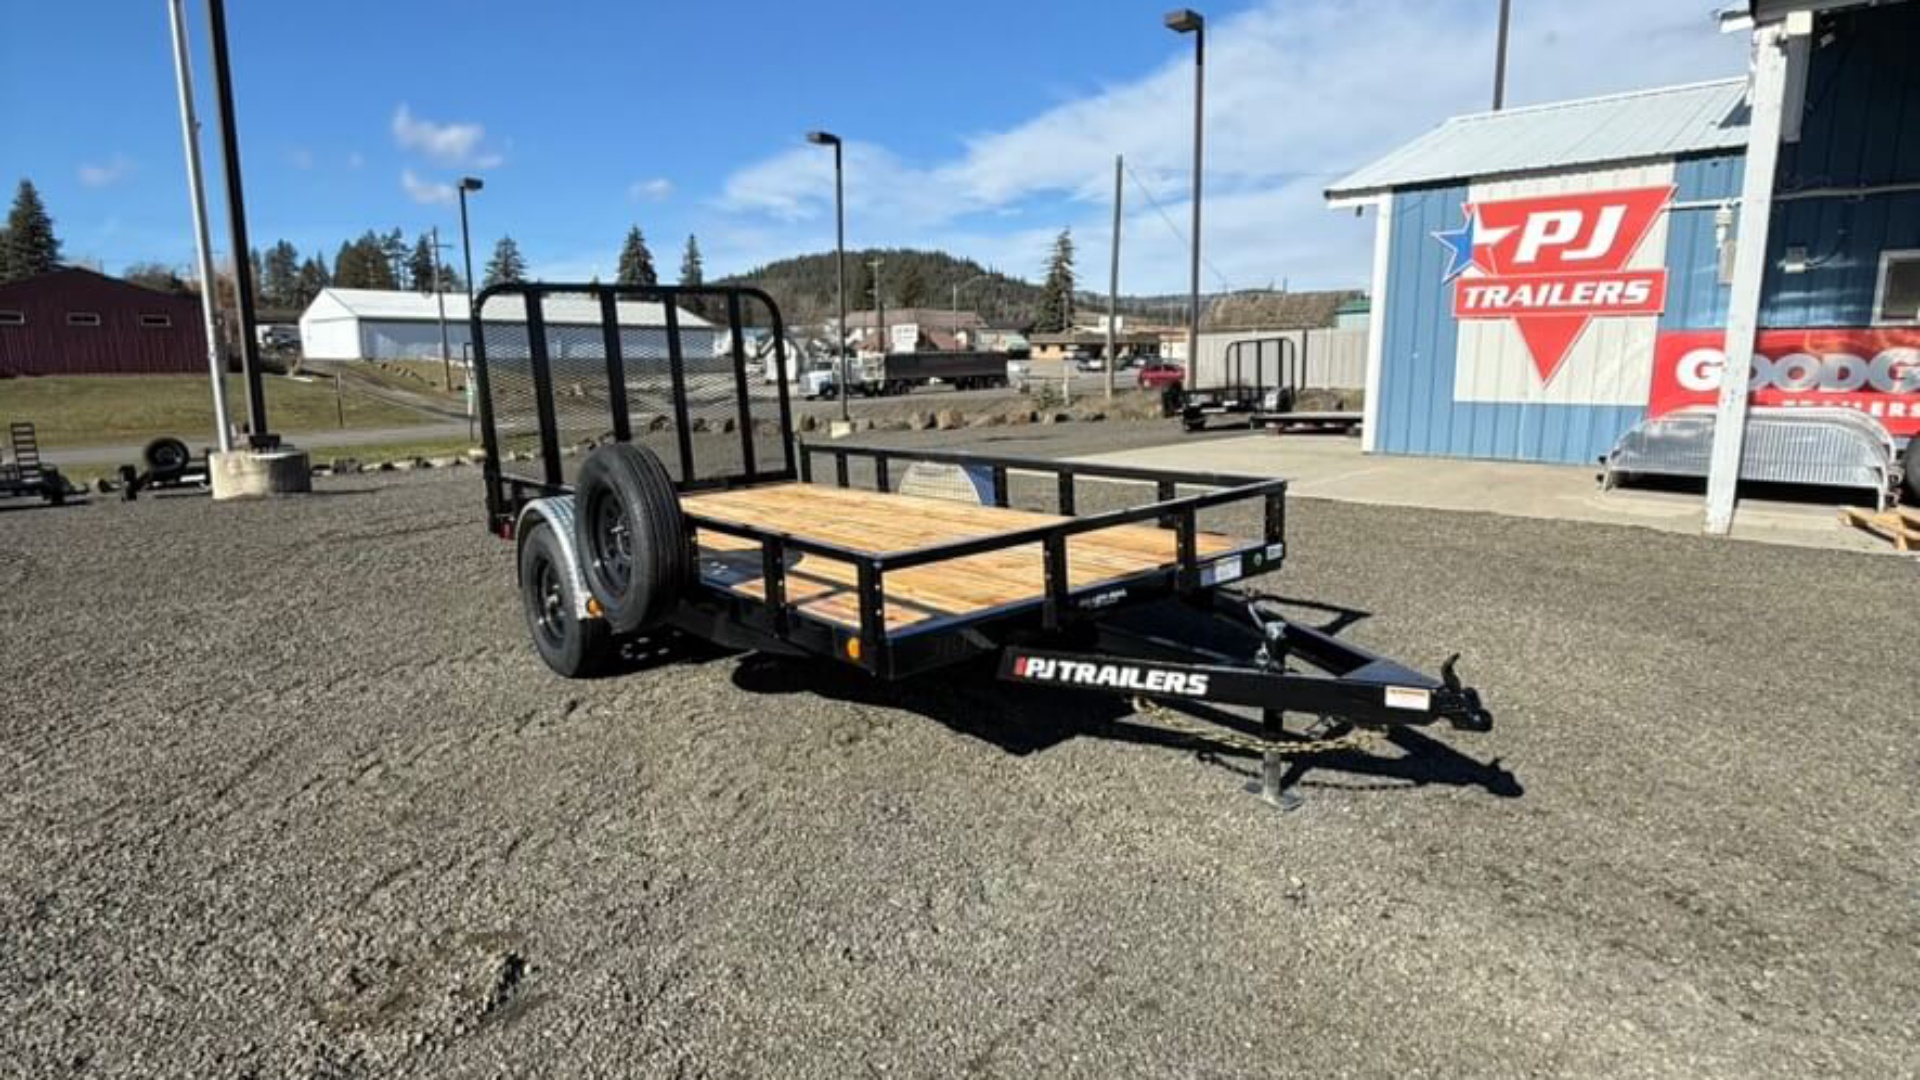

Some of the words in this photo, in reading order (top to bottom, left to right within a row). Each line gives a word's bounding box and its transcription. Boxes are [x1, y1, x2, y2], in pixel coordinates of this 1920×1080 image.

[1512, 204, 1628, 263] PJ
[1463, 279, 1653, 310] TRAILERS
[1024, 656, 1056, 679] PJ
[1058, 660, 1210, 695] TRAILERS
